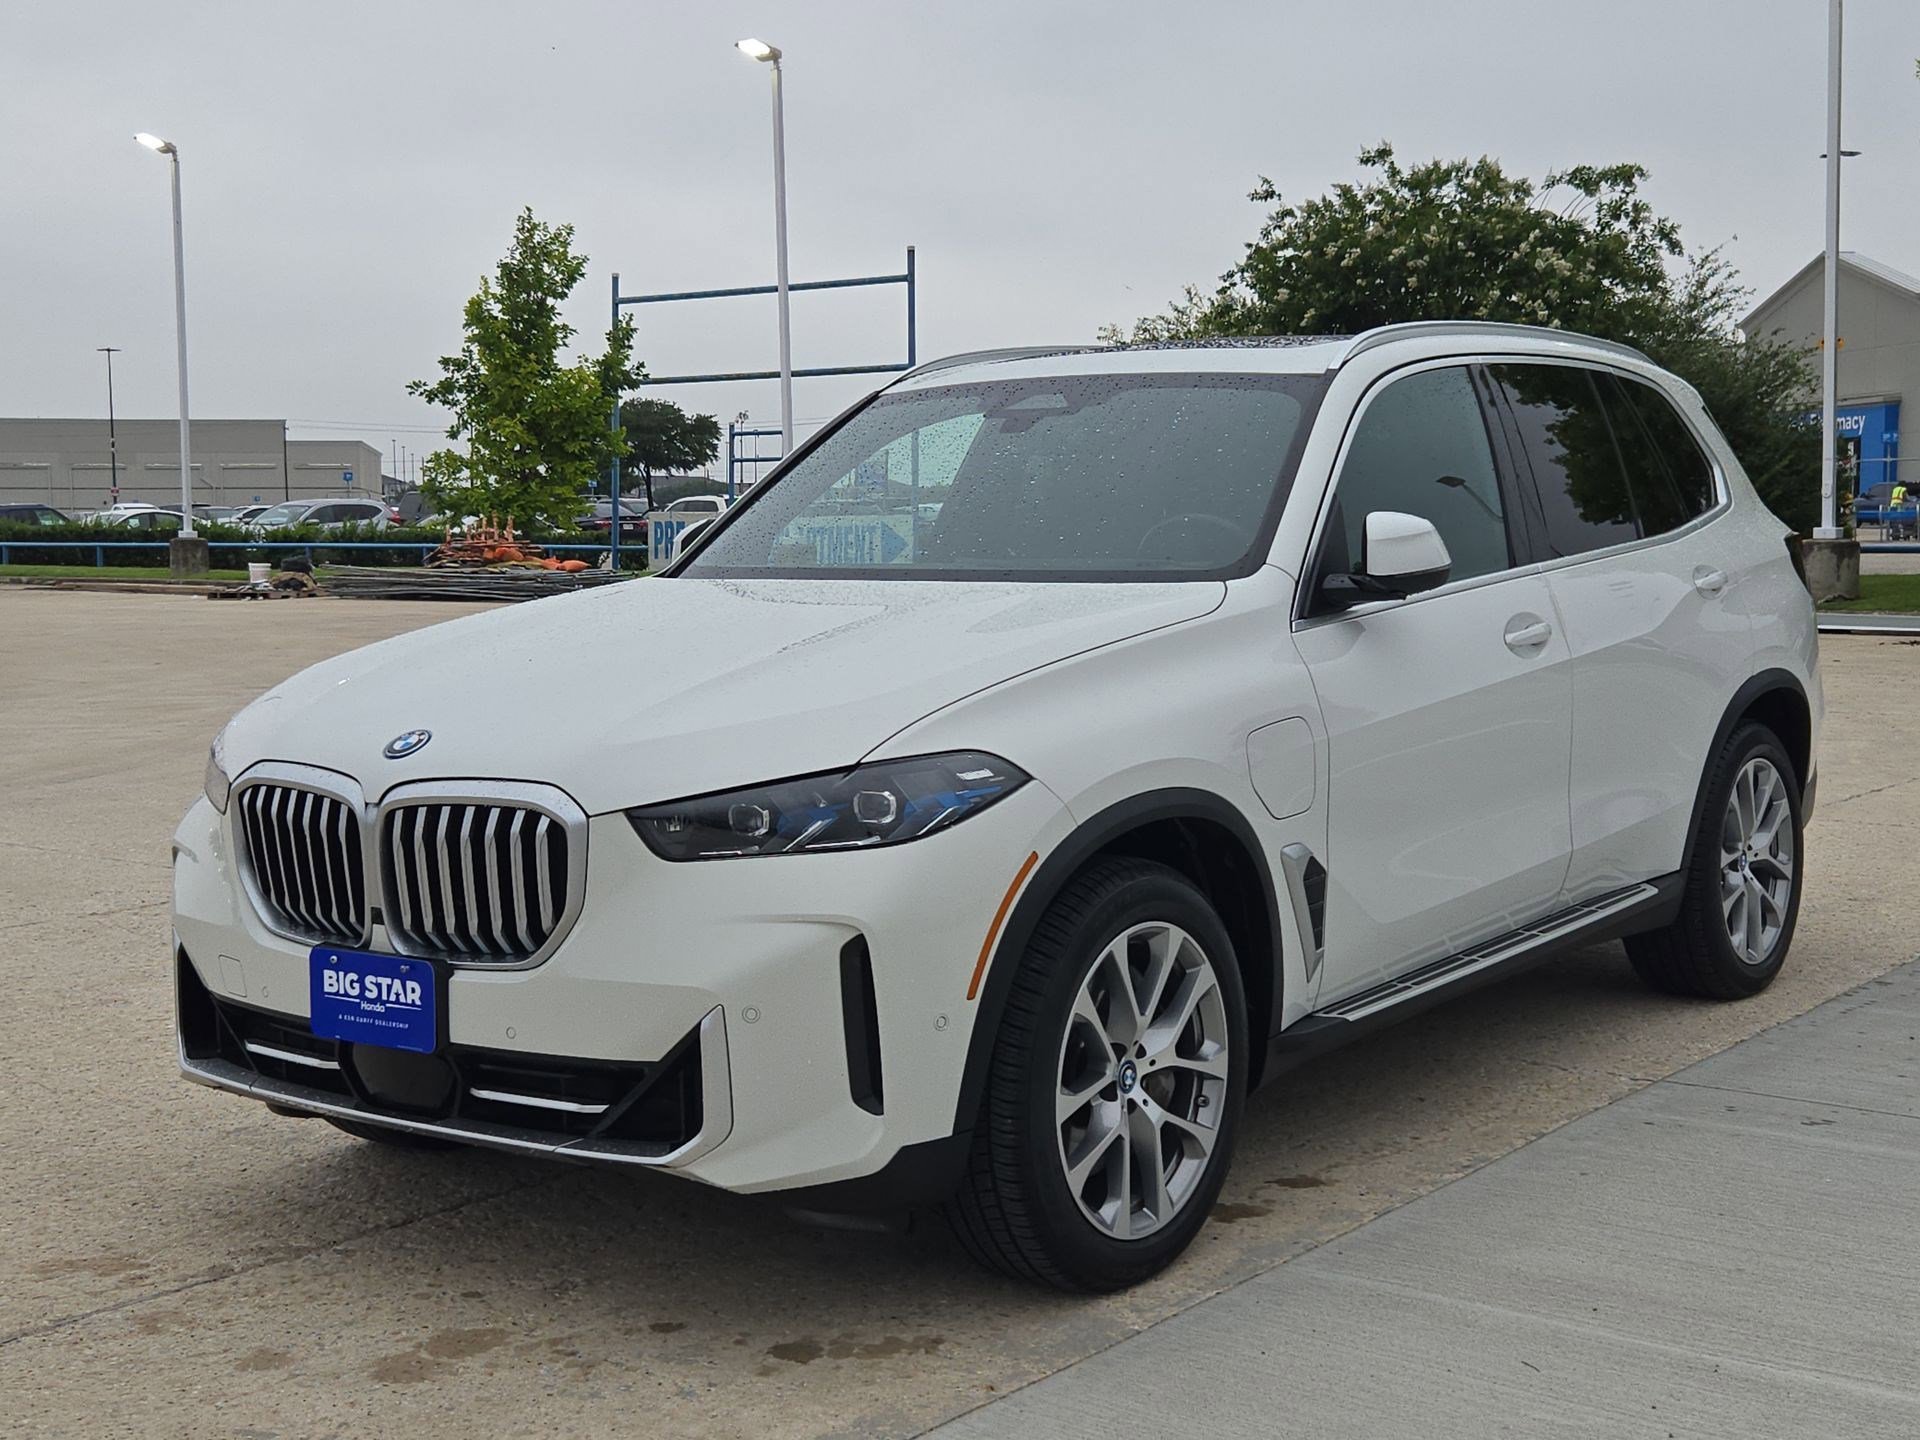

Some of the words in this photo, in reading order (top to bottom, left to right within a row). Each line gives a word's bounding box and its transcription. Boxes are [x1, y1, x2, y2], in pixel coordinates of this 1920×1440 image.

[323, 969, 360, 997] BIG
[364, 975, 422, 1006] STAR
[360, 1000, 386, 1013] Honda
[375, 1018, 409, 1029] DEALERSHIP
